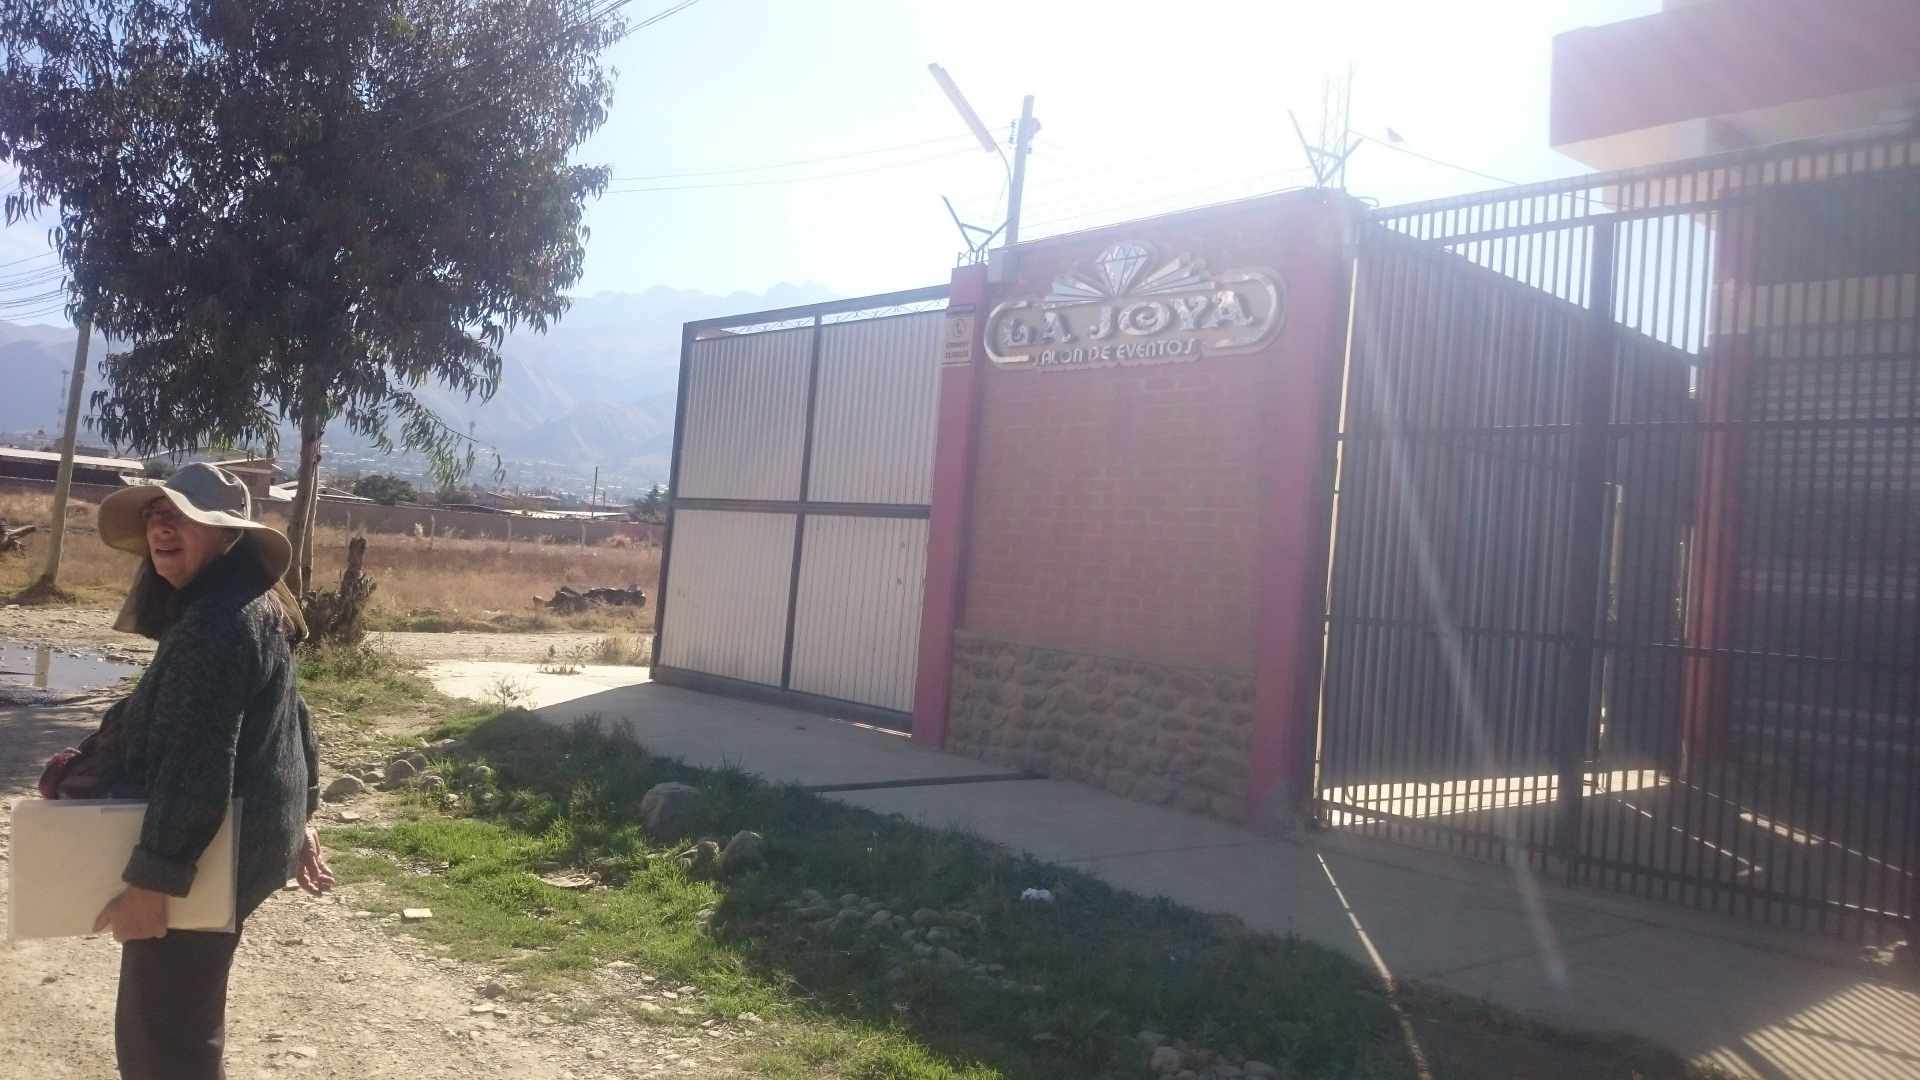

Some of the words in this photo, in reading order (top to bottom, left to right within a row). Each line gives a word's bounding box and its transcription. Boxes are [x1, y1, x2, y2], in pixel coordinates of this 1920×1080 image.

[1004, 303, 1071, 346] LA
[1088, 290, 1254, 340] JOYA
[1088, 345, 1111, 361] DE
[1116, 338, 1196, 360] EVENTOS
